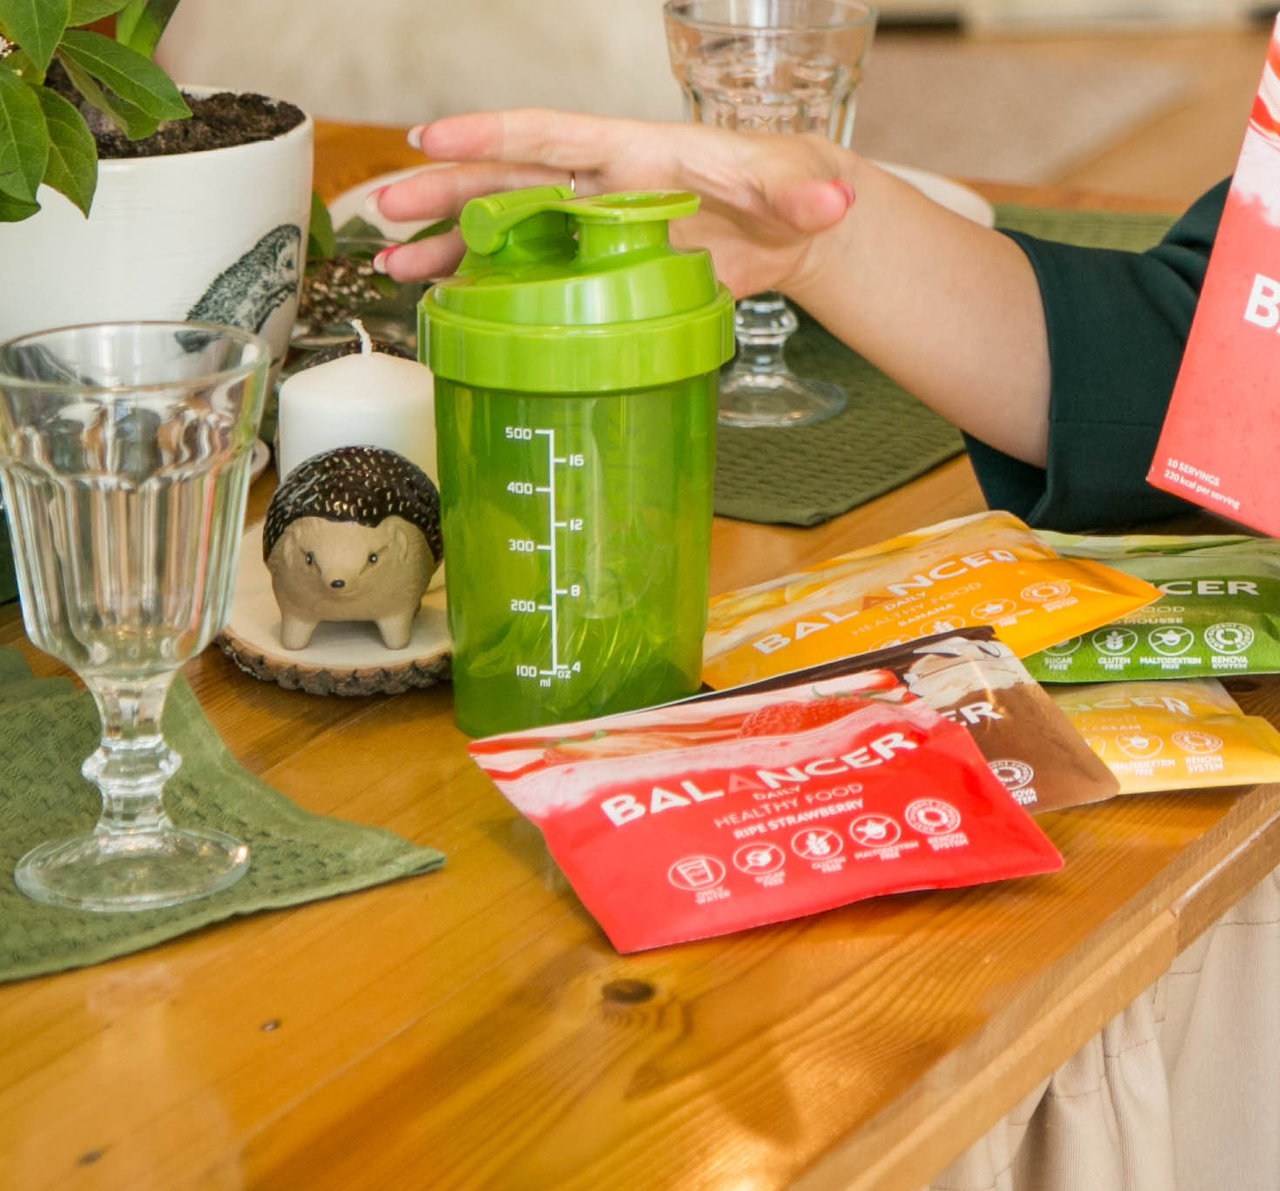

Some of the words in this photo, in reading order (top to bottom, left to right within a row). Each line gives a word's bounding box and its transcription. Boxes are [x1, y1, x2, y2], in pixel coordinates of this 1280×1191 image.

[505, 426, 532, 441] 500
[569, 454, 584, 467] 16
[1167, 458, 1179, 469] 10
[1178, 462, 1220, 487] SERVINGS
[506, 481, 533, 495] 400
[1179, 475, 1197, 490] kcal
[1195, 485, 1210, 496] per
[1210, 490, 1241, 511] serving
[569, 519, 583, 531] 12
[508, 539, 534, 552] 300
[570, 585, 581, 596] 8
[510, 600, 535, 613] 200
[883, 590, 927, 612] DAILY
[898, 603, 956, 627] BANANA
[1044, 656, 1073, 665] SUGAR
[1097, 656, 1131, 665] GLUTEN
[1211, 655, 1248, 665] RENOVA
[516, 665, 537, 678] 100
[557, 670, 571, 679] oz
[571, 662, 581, 674] 4
[540, 677, 551, 688] ml
[601, 730, 918, 828] BALANCER
[752, 785, 801, 800] DAILY
[714, 797, 799, 829] HEALTHY
[804, 782, 864, 804] FOOD
[733, 823, 767, 840] RIPE
[767, 798, 864, 831] STRAWBERRY
